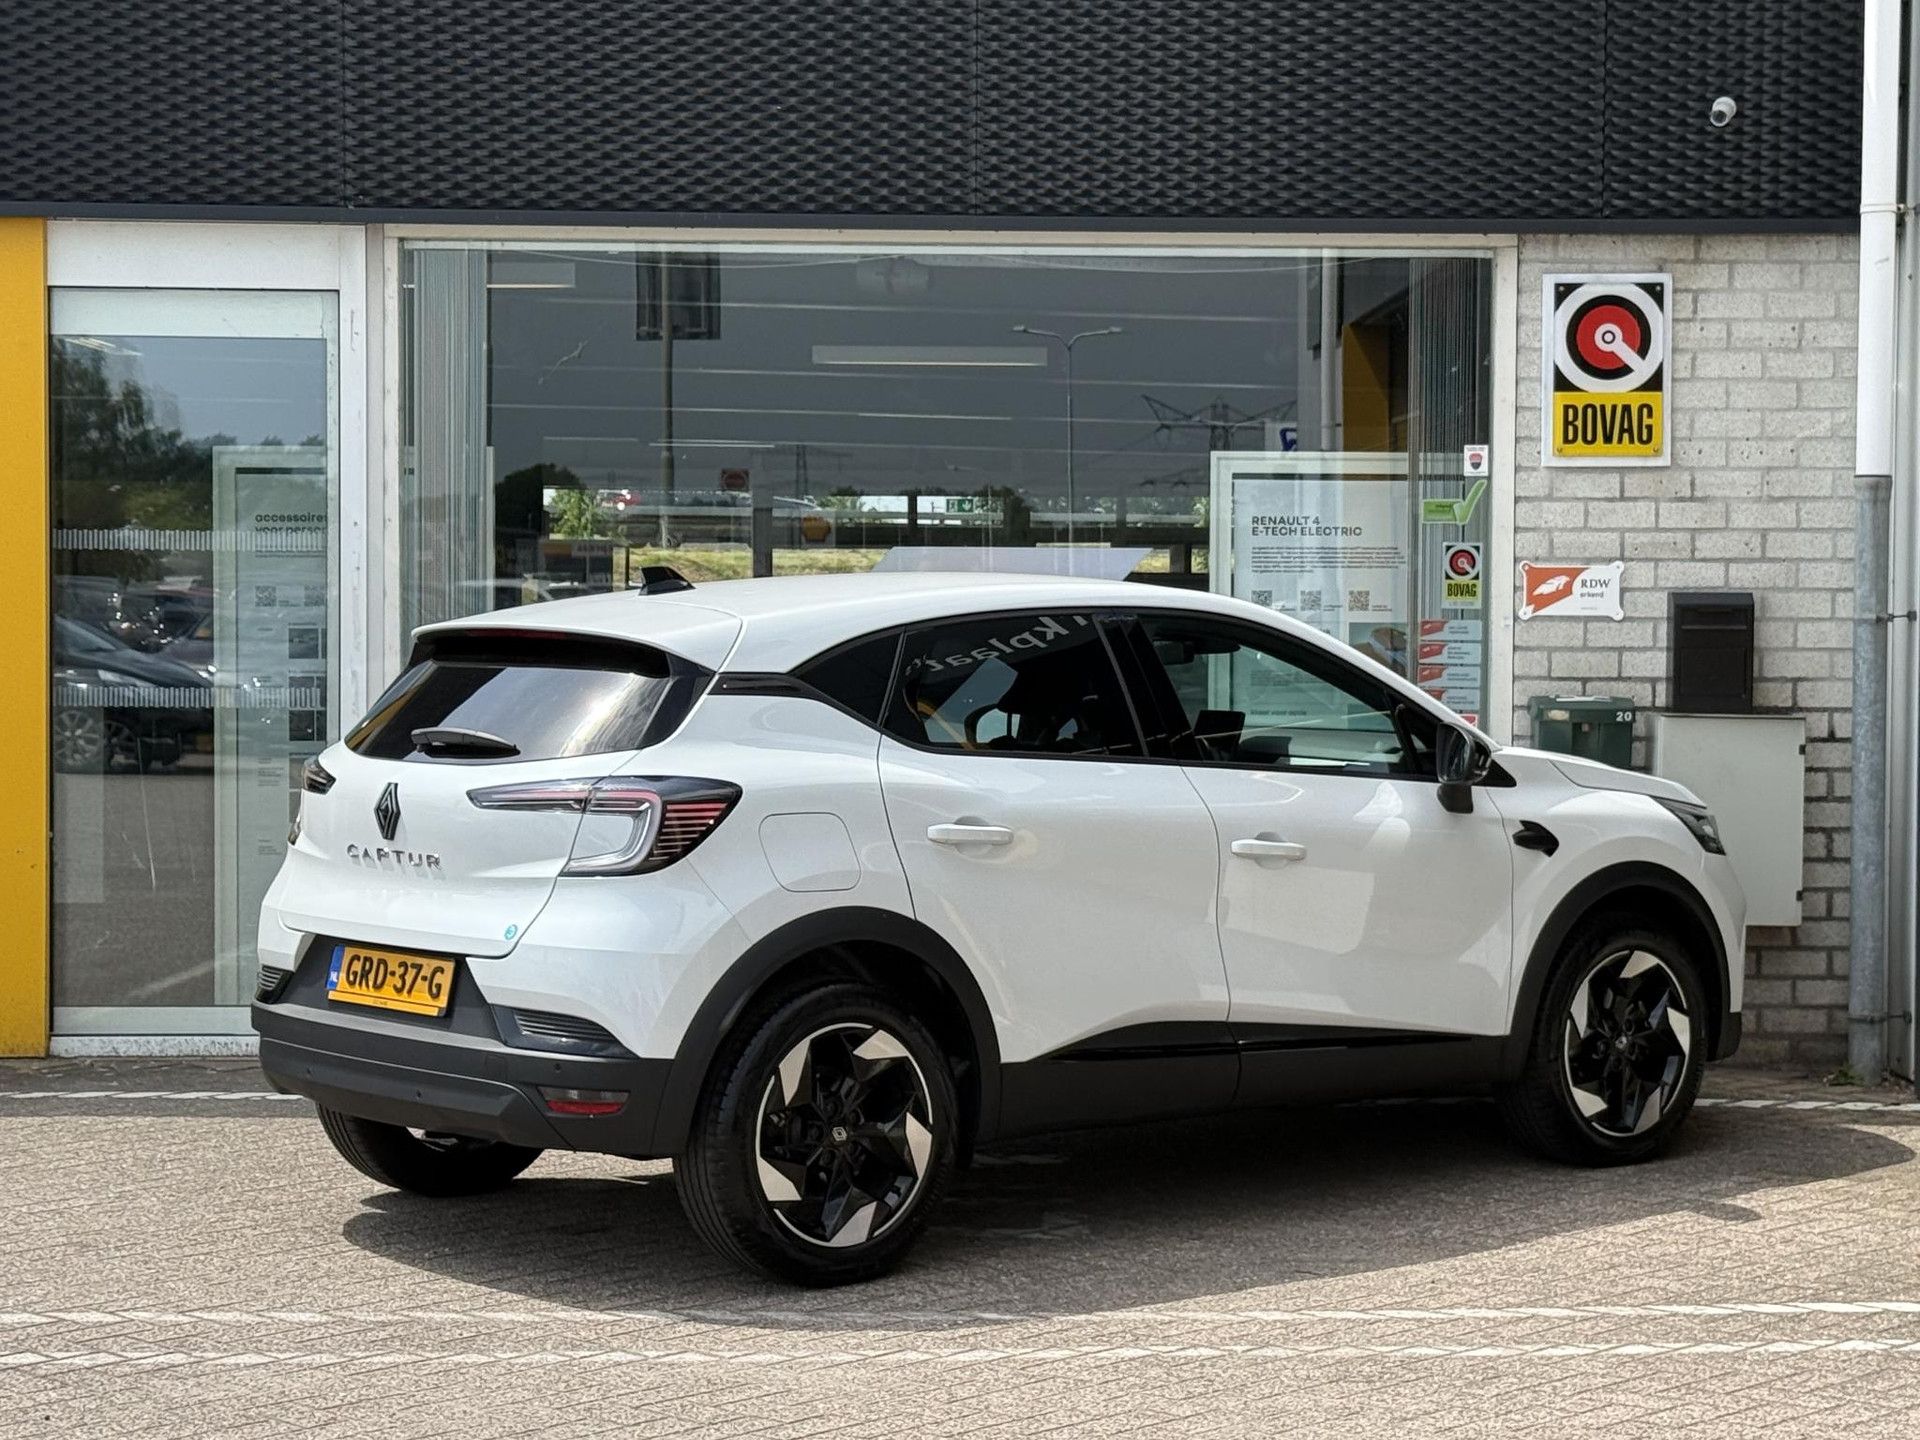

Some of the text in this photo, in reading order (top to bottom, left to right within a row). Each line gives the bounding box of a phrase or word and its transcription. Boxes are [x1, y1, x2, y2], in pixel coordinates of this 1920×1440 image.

[1562, 404, 1654, 446] BOVAG
[1251, 516, 1321, 526] RENAULT 4
[1251, 526, 1363, 537] E-TECH ELECTRIC
[1580, 578, 1611, 589] RDW
[1447, 583, 1477, 598] BOVAG
[1615, 711, 1632, 722] 20
[347, 844, 441, 869] CAPTUR
[347, 954, 444, 999] GRD-37-G
